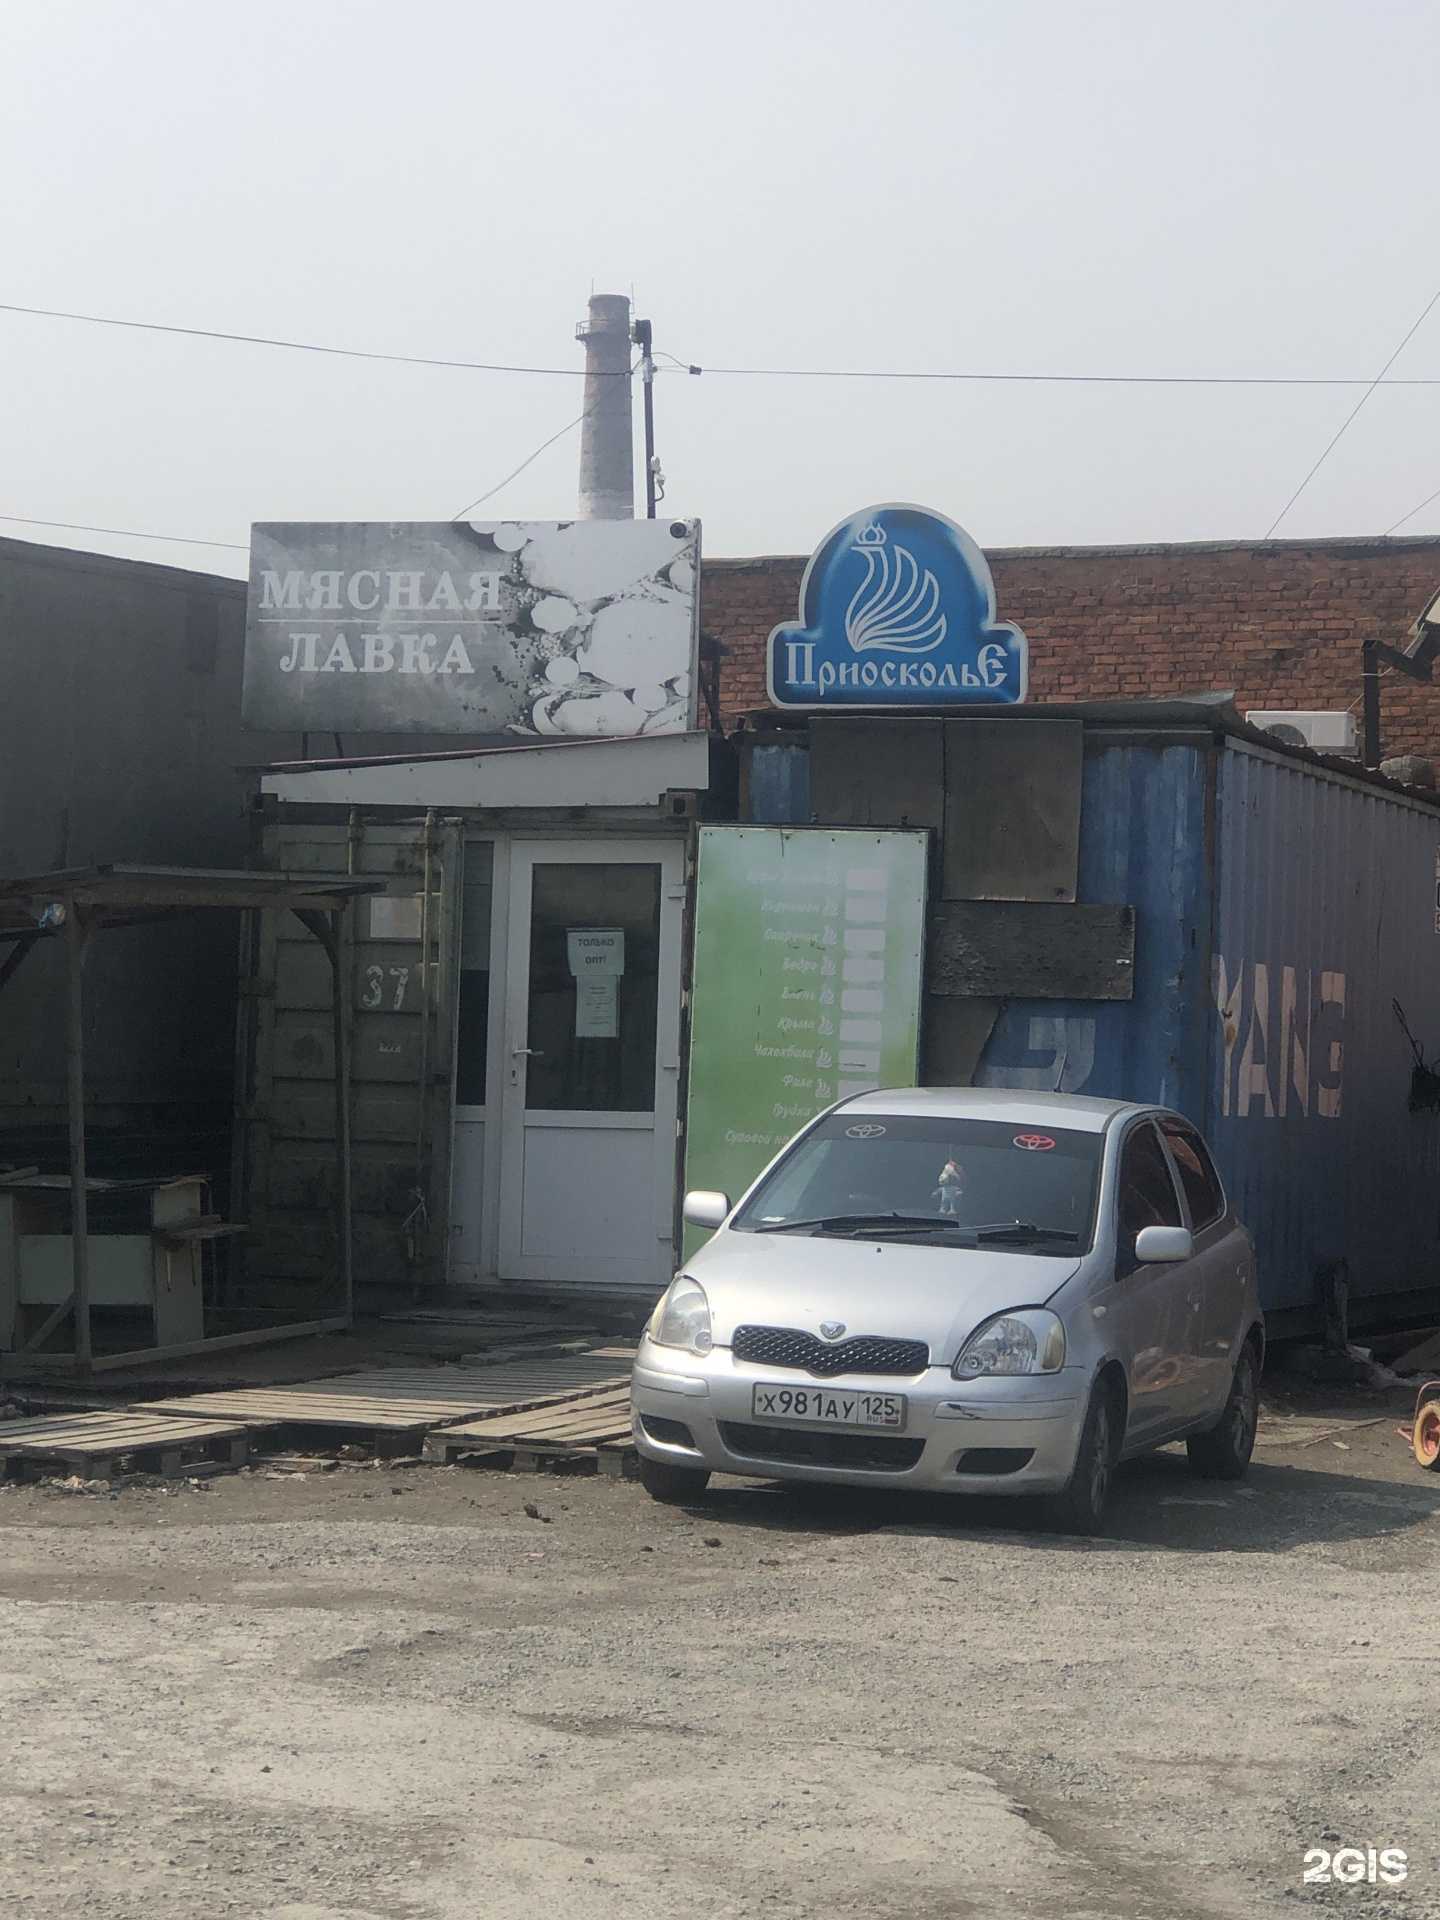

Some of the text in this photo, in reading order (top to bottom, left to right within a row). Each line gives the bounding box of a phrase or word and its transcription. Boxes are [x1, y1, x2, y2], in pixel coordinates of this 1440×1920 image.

[258, 570, 503, 611] МЯСНАЯ
[279, 633, 475, 674] ЛАВКА
[363, 965, 409, 1010] 37
[861, 1397, 896, 1416] 125
